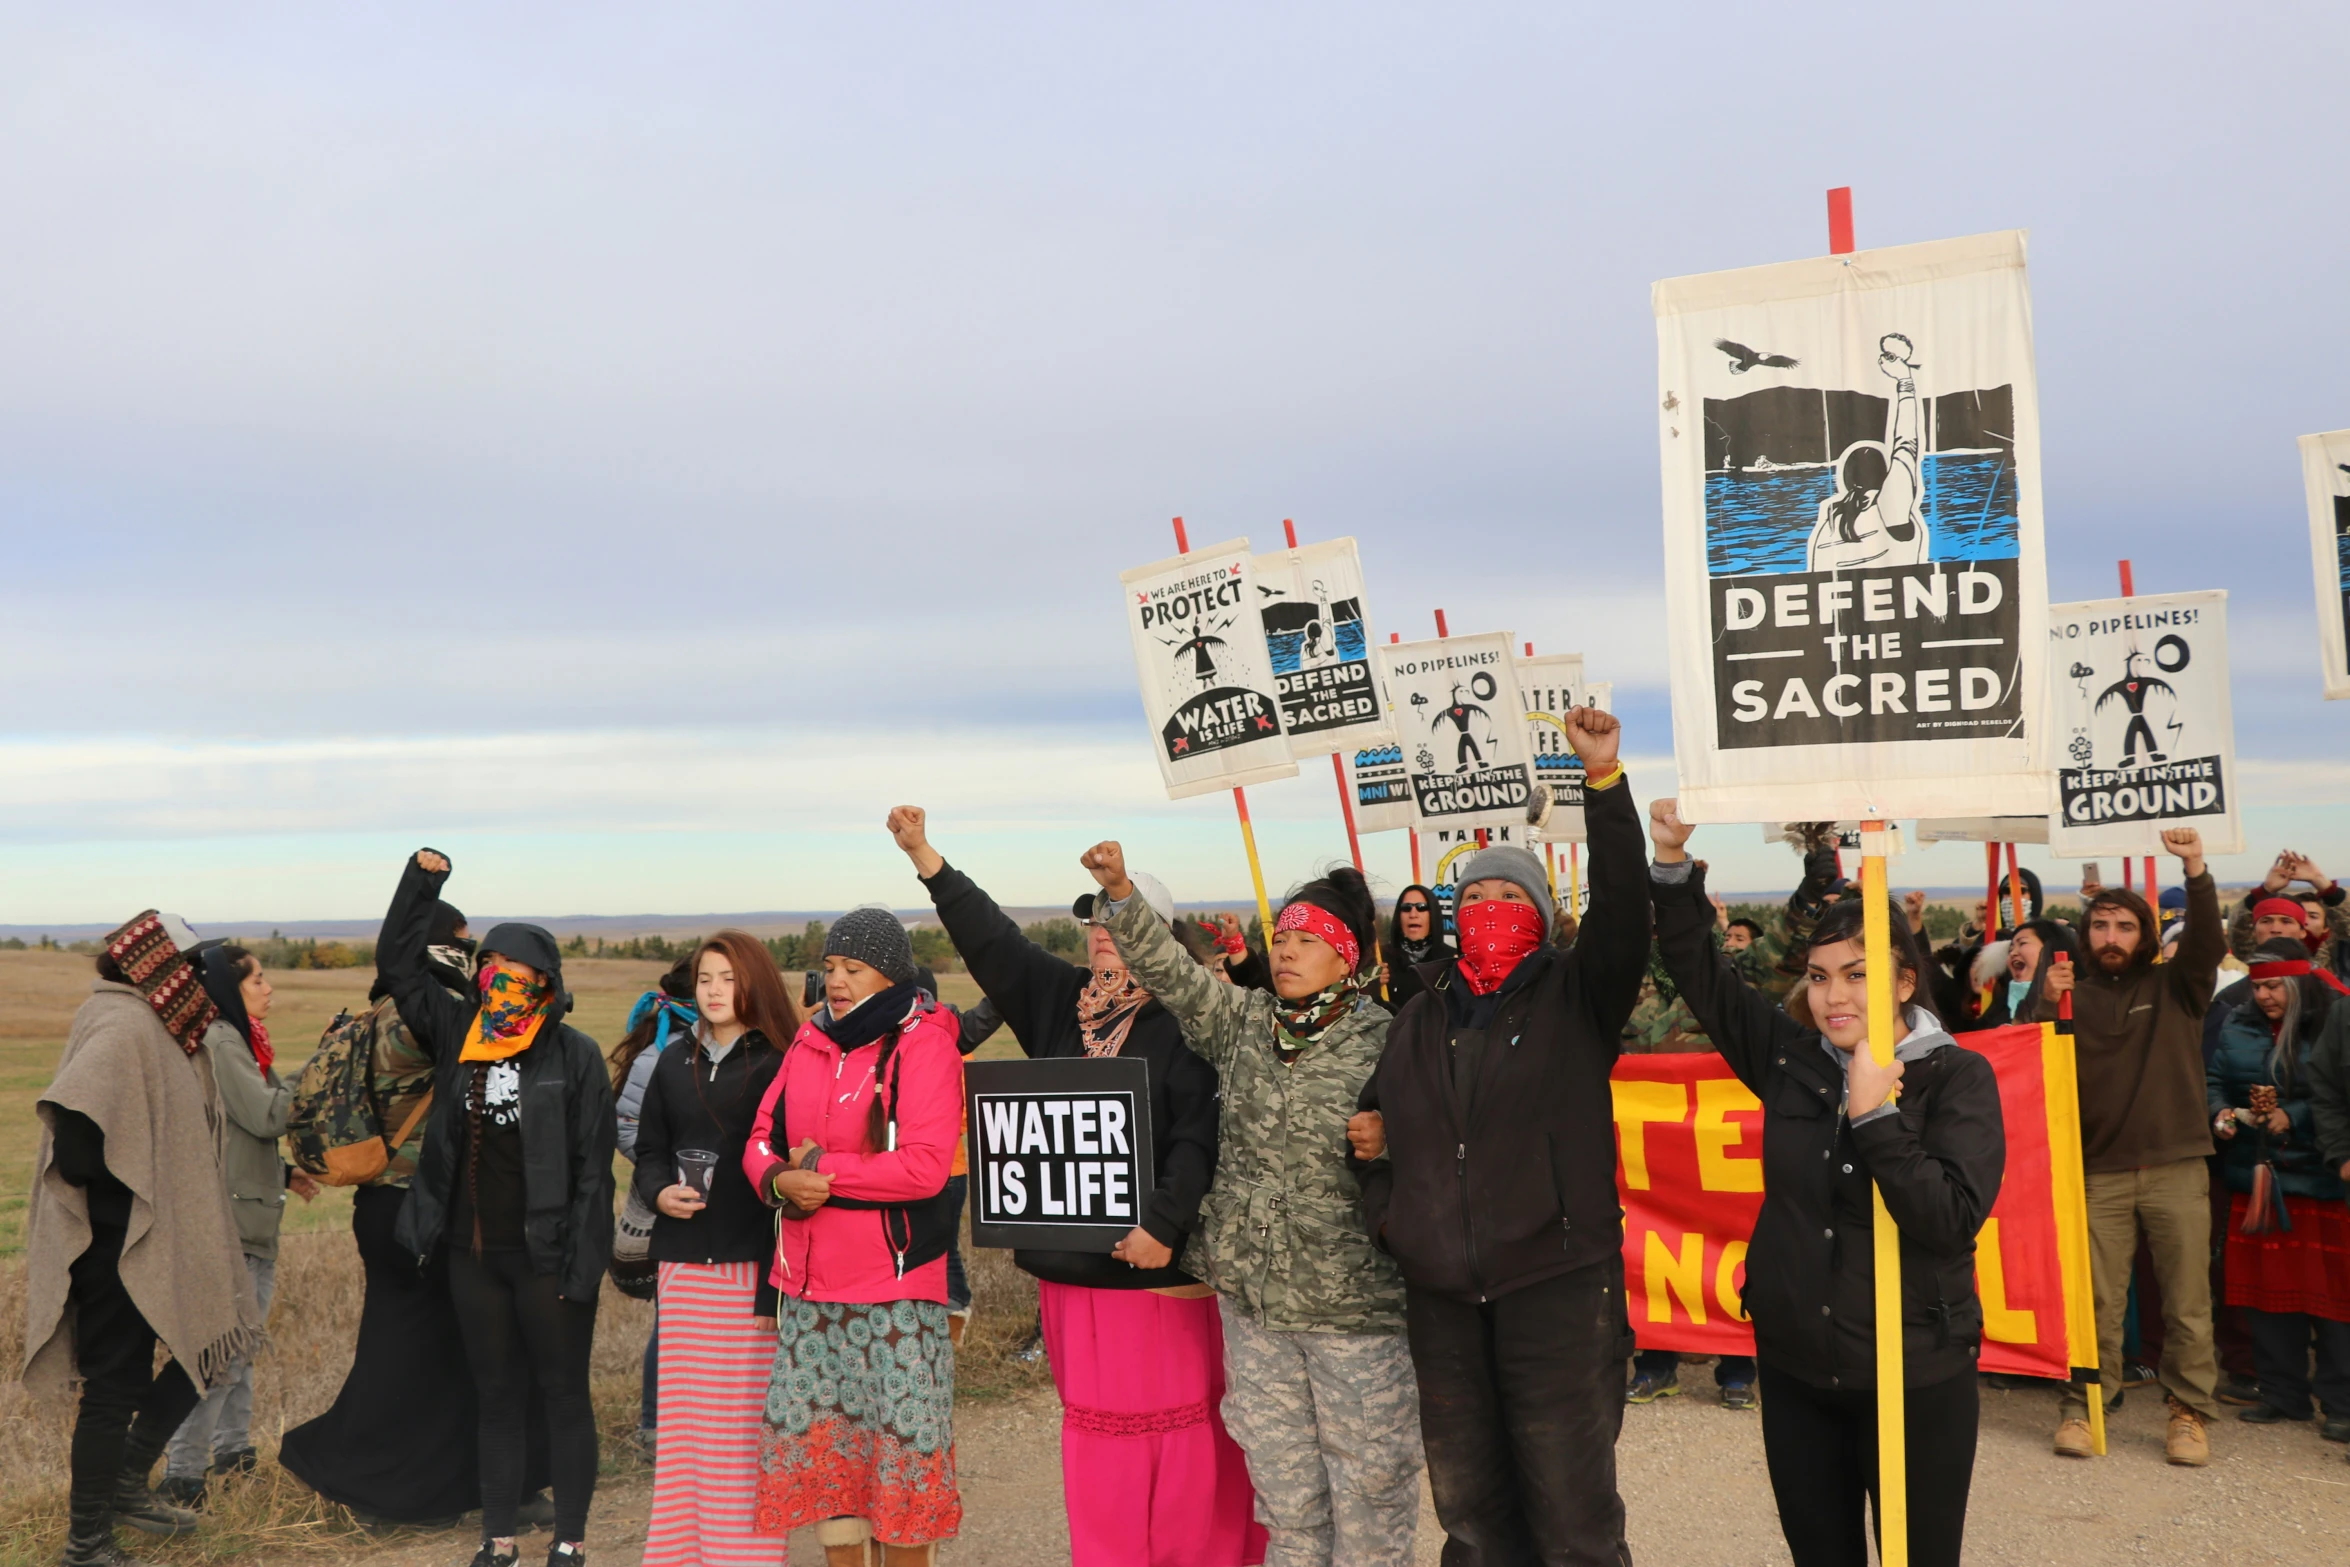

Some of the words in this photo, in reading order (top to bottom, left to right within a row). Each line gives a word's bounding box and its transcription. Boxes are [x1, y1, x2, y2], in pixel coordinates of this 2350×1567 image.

[1151, 588, 1165, 600] WE
[1167, 581, 1187, 595] ARE
[1188, 573, 1212, 589] HERE
[1213, 569, 1226, 581] TO
[1141, 578, 1242, 630] PROTECT
[1725, 571, 2004, 631] DEFEND
[2050, 623, 2080, 641] NO
[2089, 609, 2199, 636] PIPELINES!
[1823, 632, 1902, 662] THE
[1275, 664, 1366, 695] DEFEND
[1395, 662, 1416, 677] NO
[1421, 651, 1500, 673] PIPELINES!
[1310, 688, 1338, 702] THE
[1731, 667, 2002, 723] SACRED
[1175, 692, 1264, 735] WATER
[1283, 697, 1373, 727] SACRED
[1199, 728, 1214, 742] IS
[1216, 720, 1246, 738] LIFE
[1418, 775, 1454, 790] KEEP
[1457, 774, 1472, 786] IT
[1475, 771, 1490, 783] IN
[1493, 768, 1523, 781] THE
[2066, 771, 2116, 790] KEEP
[2120, 769, 2139, 784] IT
[2144, 767, 2167, 782] IN
[2172, 762, 2214, 779] THE
[1424, 782, 1527, 812] GROUND
[2068, 781, 2217, 821] GROUND
[982, 1100, 1131, 1155] WATER
[989, 1160, 1027, 1215] IS
[1039, 1161, 1131, 1217] LIFE
